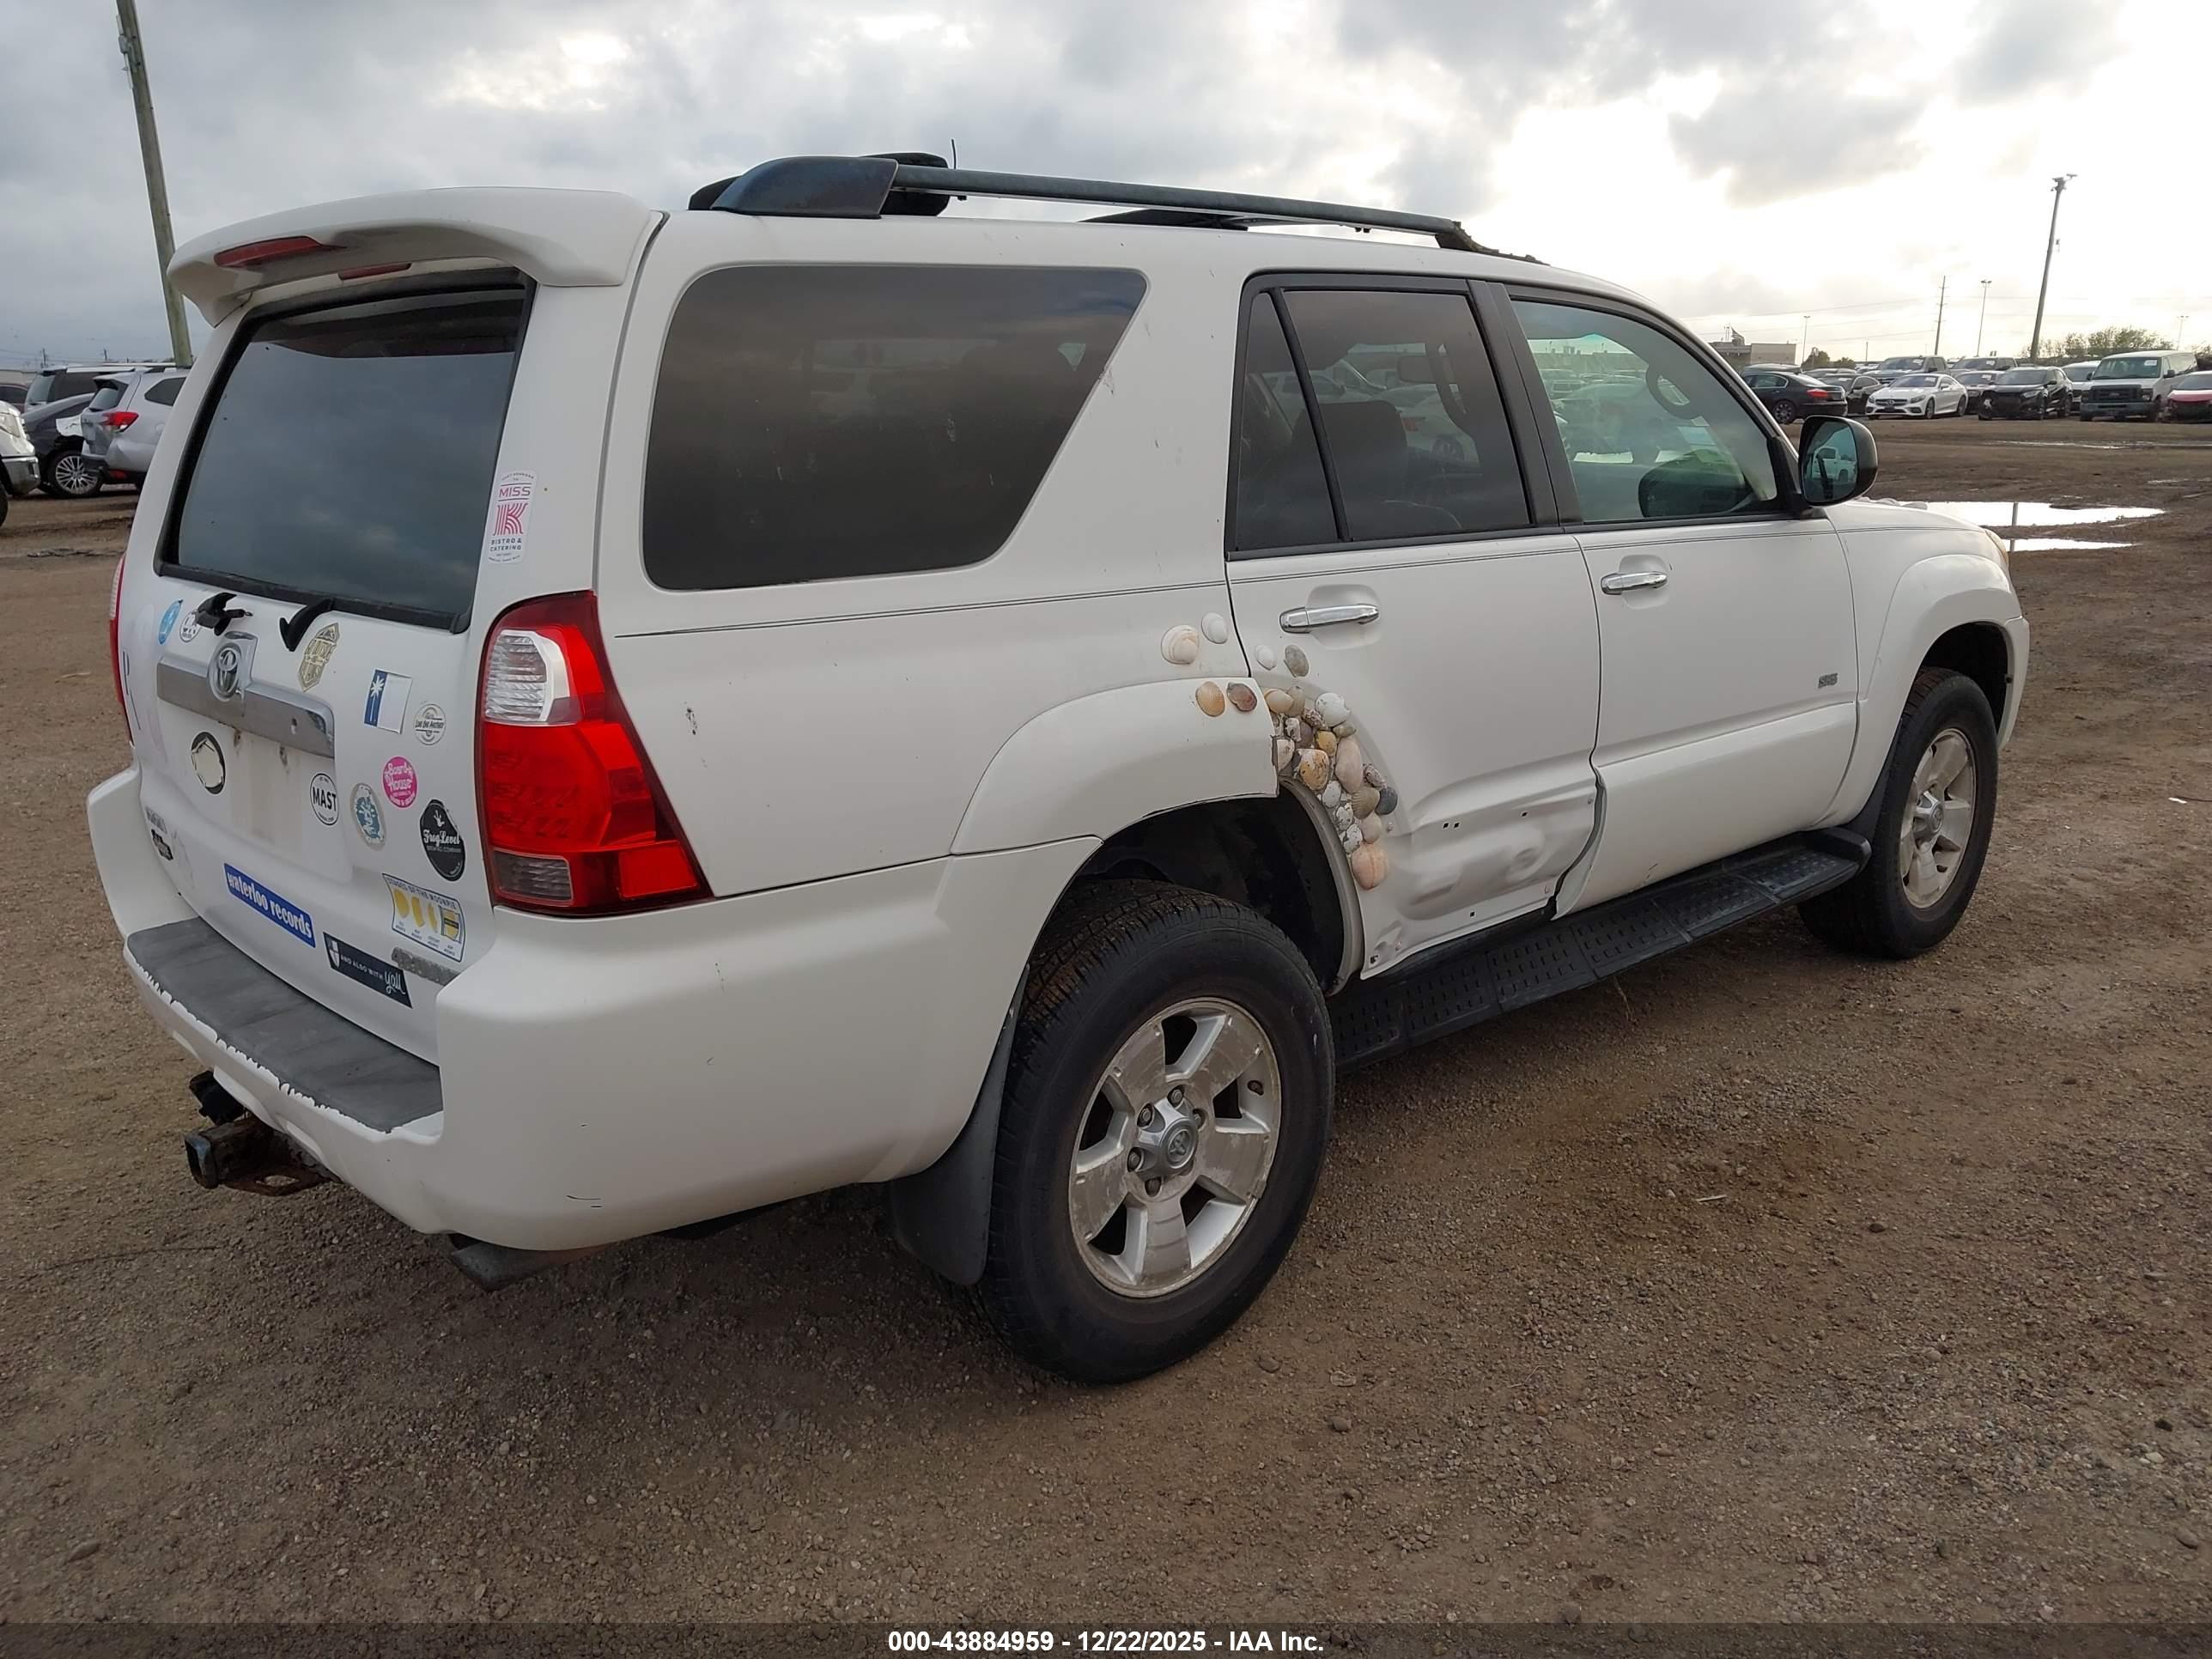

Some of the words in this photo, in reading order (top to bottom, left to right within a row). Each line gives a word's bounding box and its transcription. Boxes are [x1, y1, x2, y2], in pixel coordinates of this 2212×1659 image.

[499, 486, 532, 498] MISS
[493, 502, 529, 537] K
[313, 786, 337, 811] MAST
[423, 829, 441, 847] Frog
[440, 830, 461, 845] Level
[227, 872, 268, 910] waterloo
[270, 899, 312, 939] records
[341, 954, 352, 965] AND
[353, 961, 368, 973] ALSO
[368, 968, 384, 980] WITH
